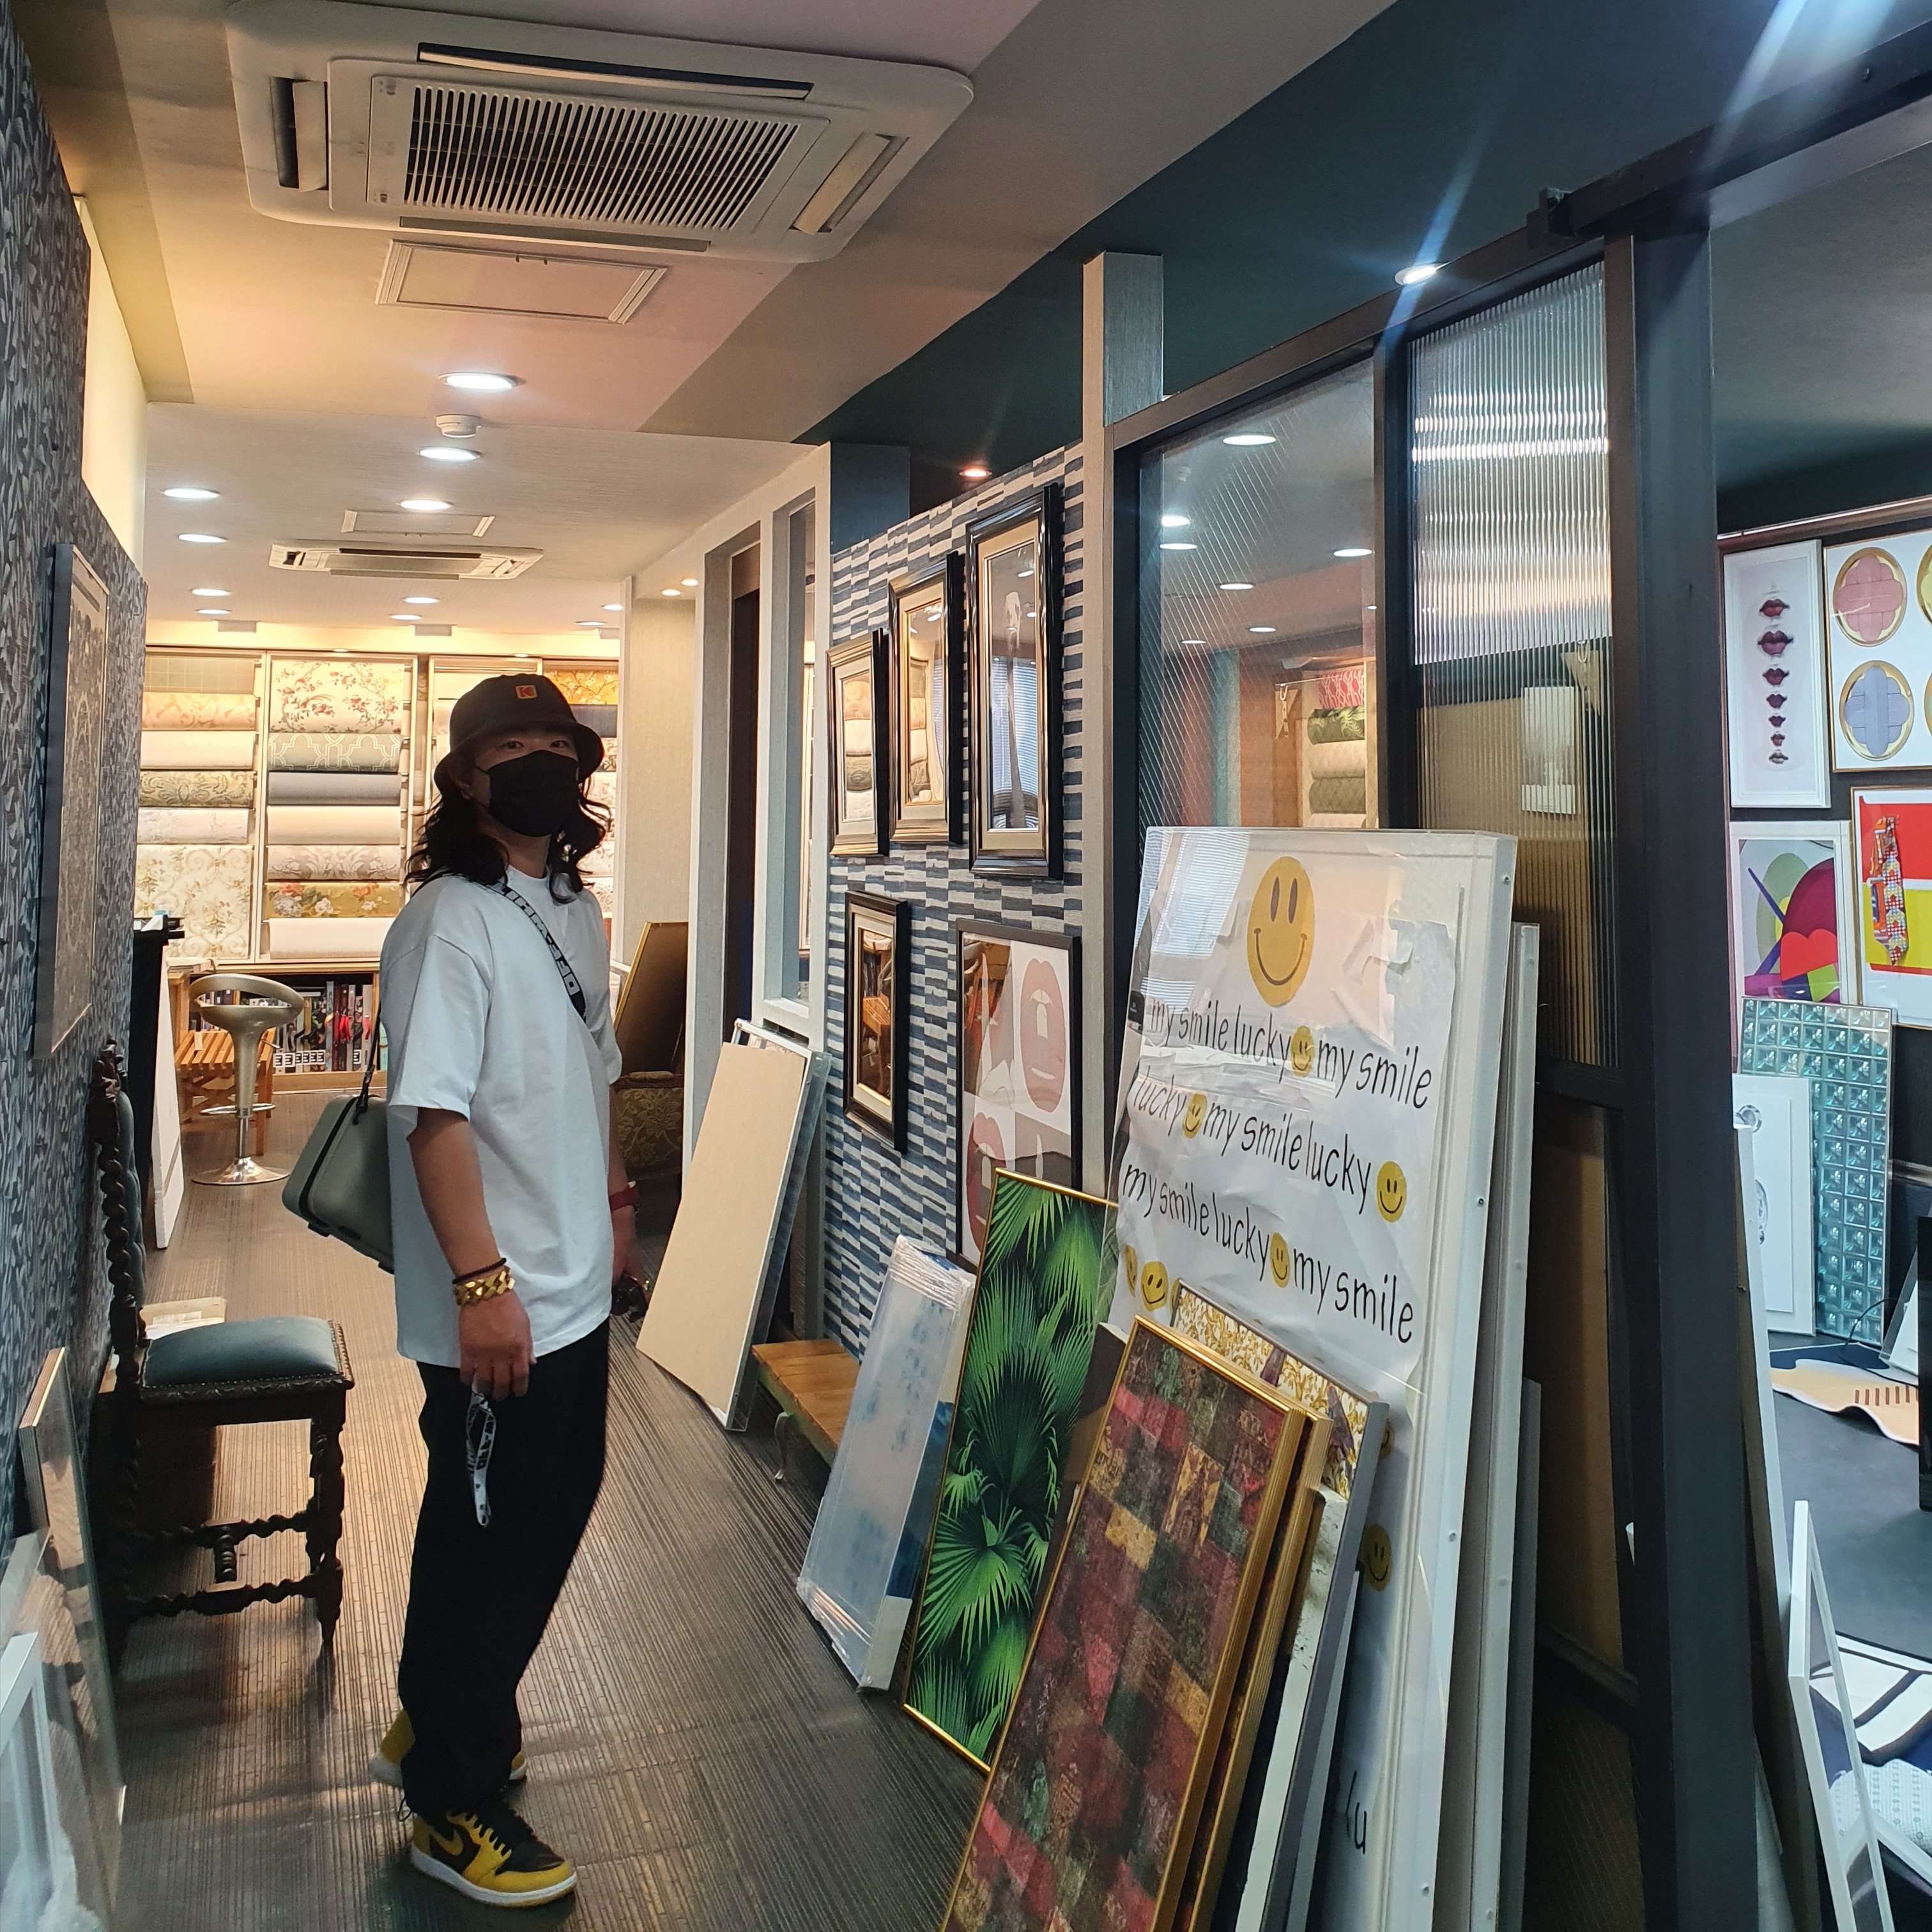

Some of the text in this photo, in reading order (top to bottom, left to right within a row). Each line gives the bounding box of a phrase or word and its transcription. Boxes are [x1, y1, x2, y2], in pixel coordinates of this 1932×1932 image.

[486, 882, 581, 996] OFF-WHIT
[1151, 998, 1432, 1109] my smile lucky my smile
[1133, 1065, 1371, 1215] lucky my smile lucky
[1122, 1164, 1413, 1344] my smile lucky my smile
